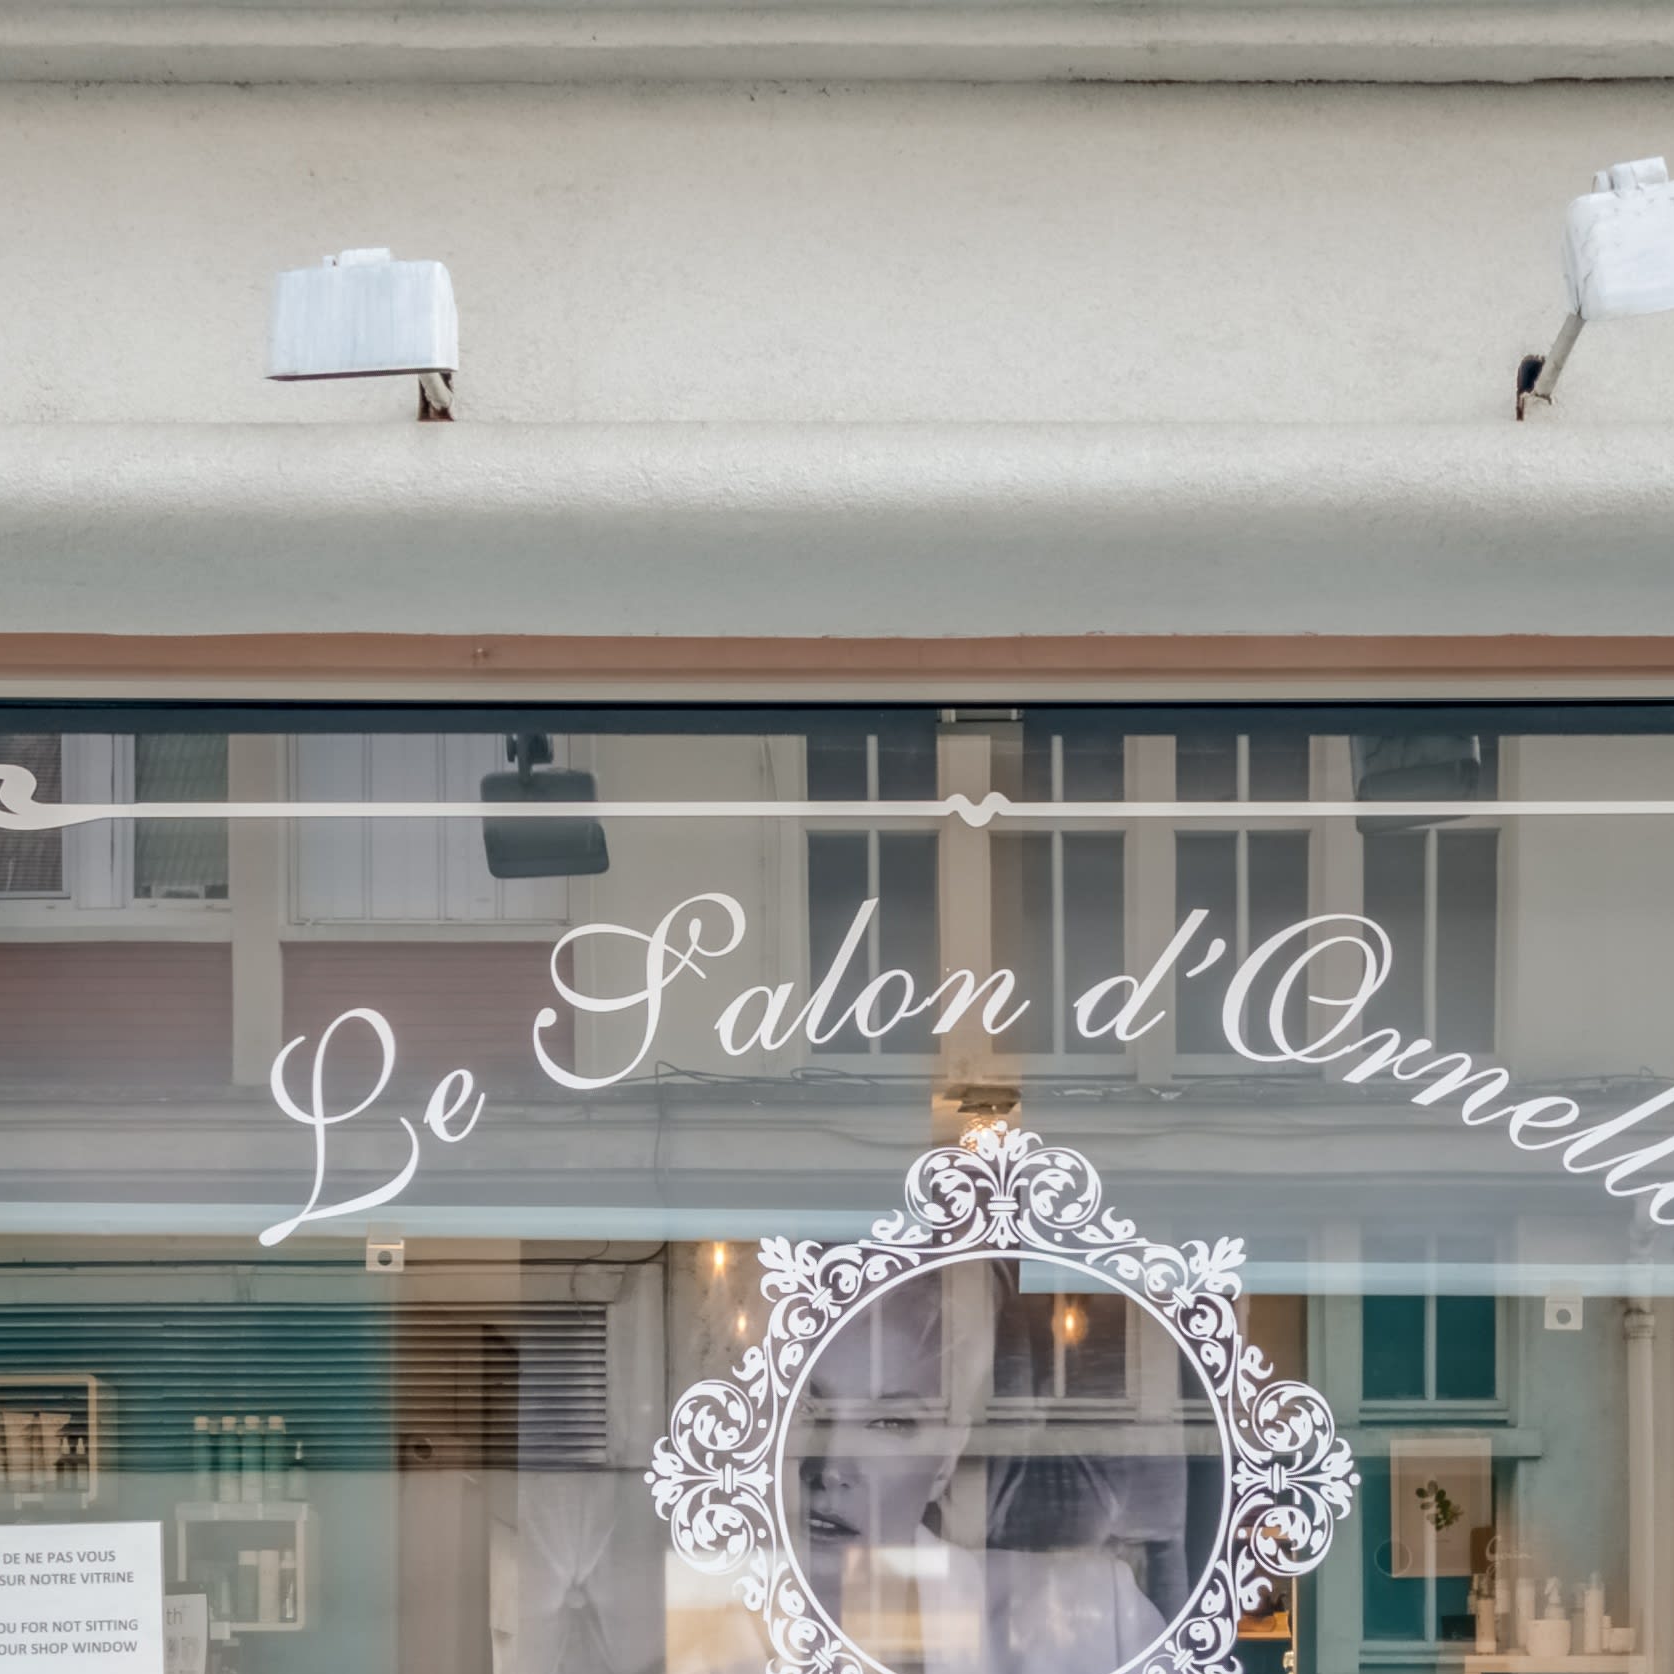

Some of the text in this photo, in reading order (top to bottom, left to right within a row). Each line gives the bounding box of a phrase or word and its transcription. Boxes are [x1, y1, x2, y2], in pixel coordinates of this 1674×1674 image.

[257, 1005, 486, 1249] Le
[533, 892, 1031, 1091] Salon
[2, 1552, 21, 1565] DE
[25, 1552, 43, 1564] NE
[47, 1551, 74, 1563] PAS
[76, 1550, 116, 1562] VOUS
[30, 1573, 76, 1586] NOTRE
[80, 1571, 134, 1584] VITRINE
[21, 1621, 48, 1634] FOR
[52, 1620, 81, 1633] NOT
[85, 1618, 139, 1632] SITTING
[30, 1642, 69, 1655] SHOP
[72, 1641, 138, 1654] WINDOW
